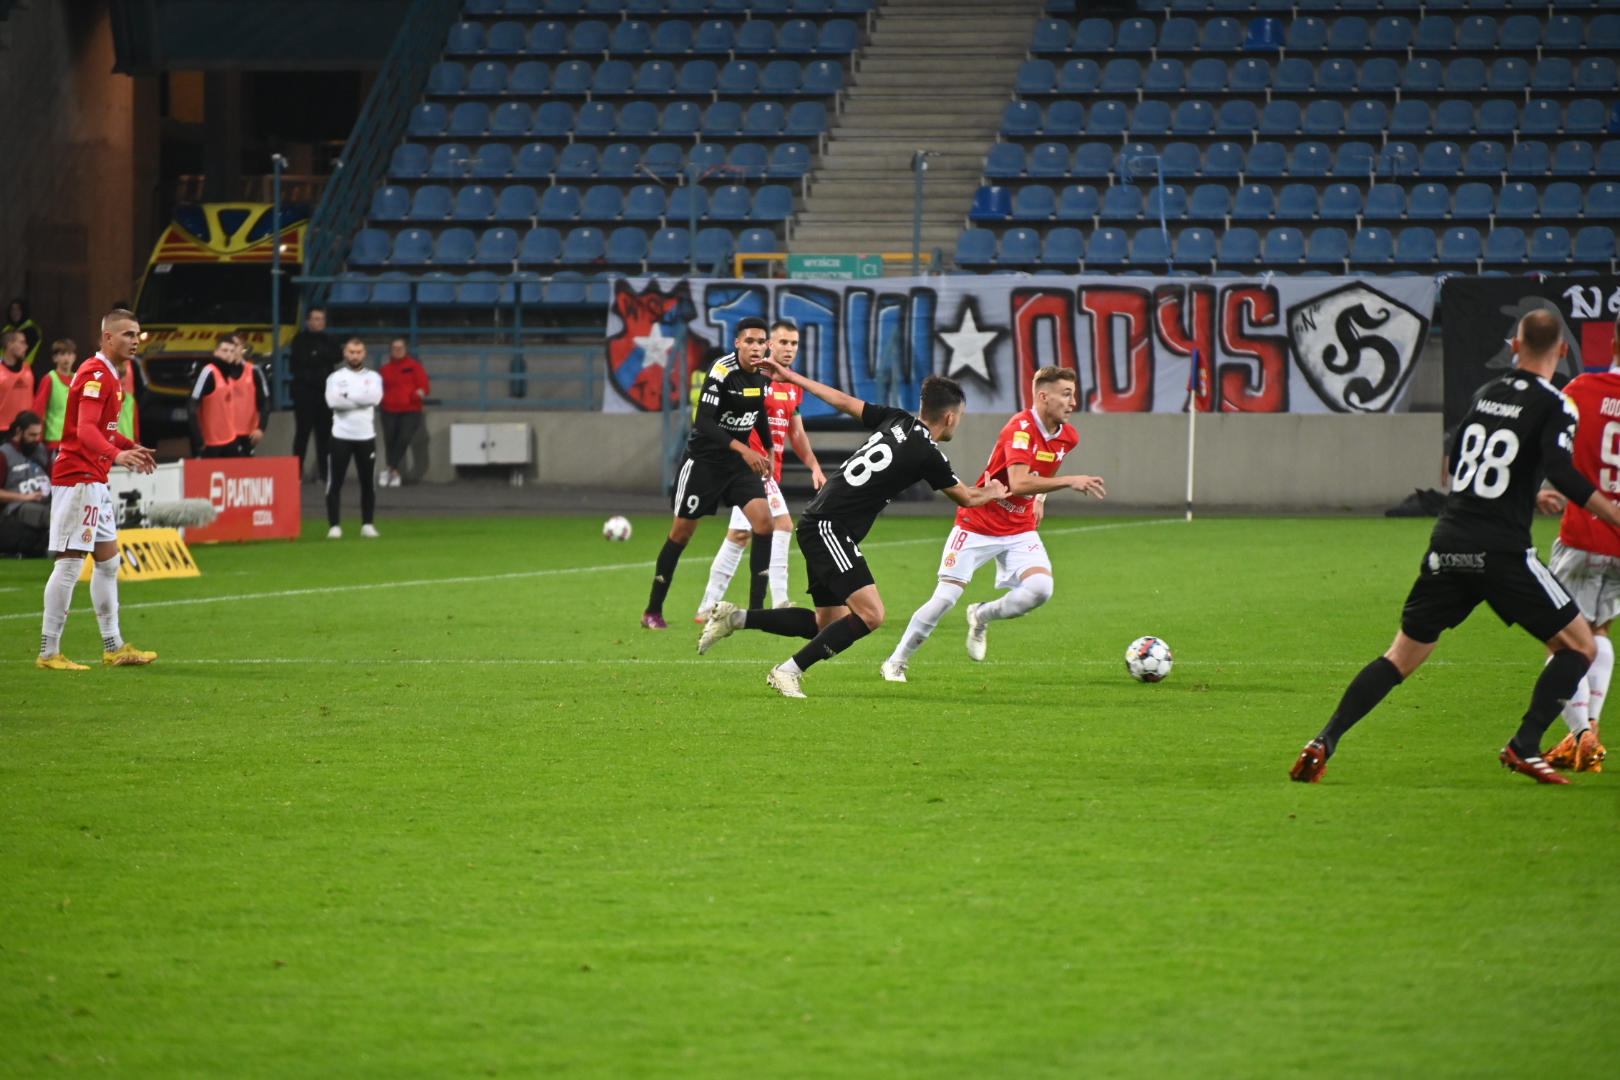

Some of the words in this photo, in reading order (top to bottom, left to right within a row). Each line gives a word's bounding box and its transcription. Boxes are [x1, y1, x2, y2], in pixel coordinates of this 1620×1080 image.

[862, 263, 878, 276] C1
[1452, 422, 1520, 499] 88
[227, 477, 274, 507] PLATINUM
[686, 494, 700, 514] 9
[82, 505, 99, 527] 20
[951, 531, 968, 551] 18
[1439, 552, 1487, 568] COSINUS
